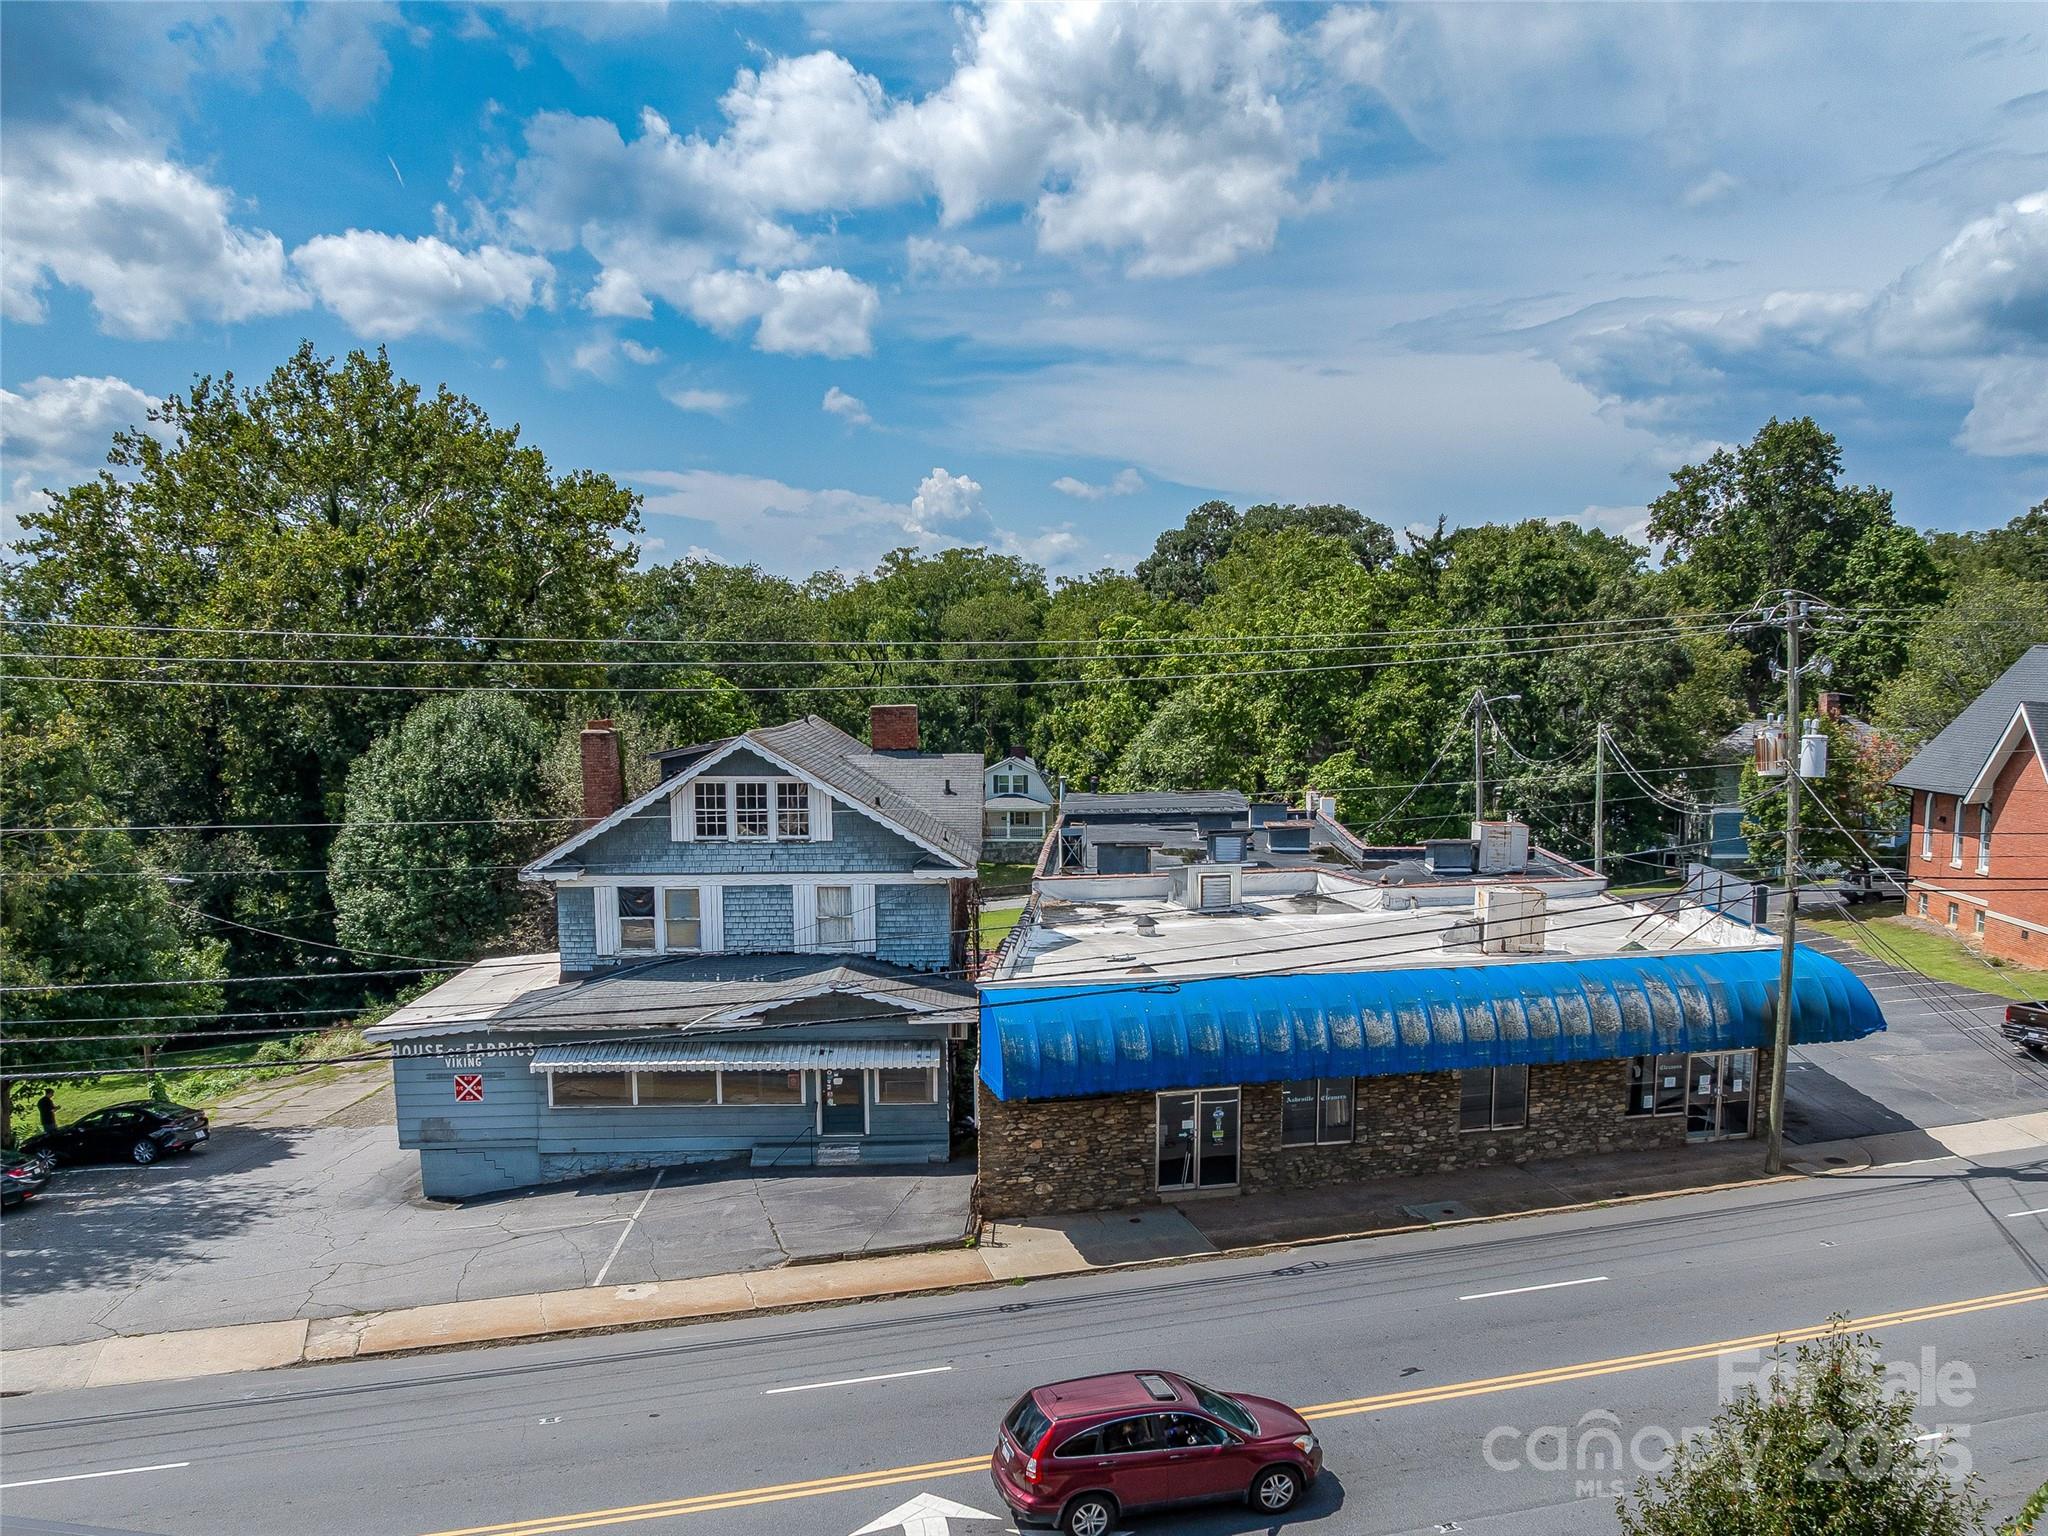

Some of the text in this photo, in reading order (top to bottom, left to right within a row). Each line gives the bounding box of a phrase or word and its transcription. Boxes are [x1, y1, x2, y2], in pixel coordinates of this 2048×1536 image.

[391, 1043, 444, 1059] HOUSE
[466, 1042, 536, 1057] FABRICS
[445, 1057, 482, 1068] VIKING
[1320, 1094, 1347, 1102] Cleaners
